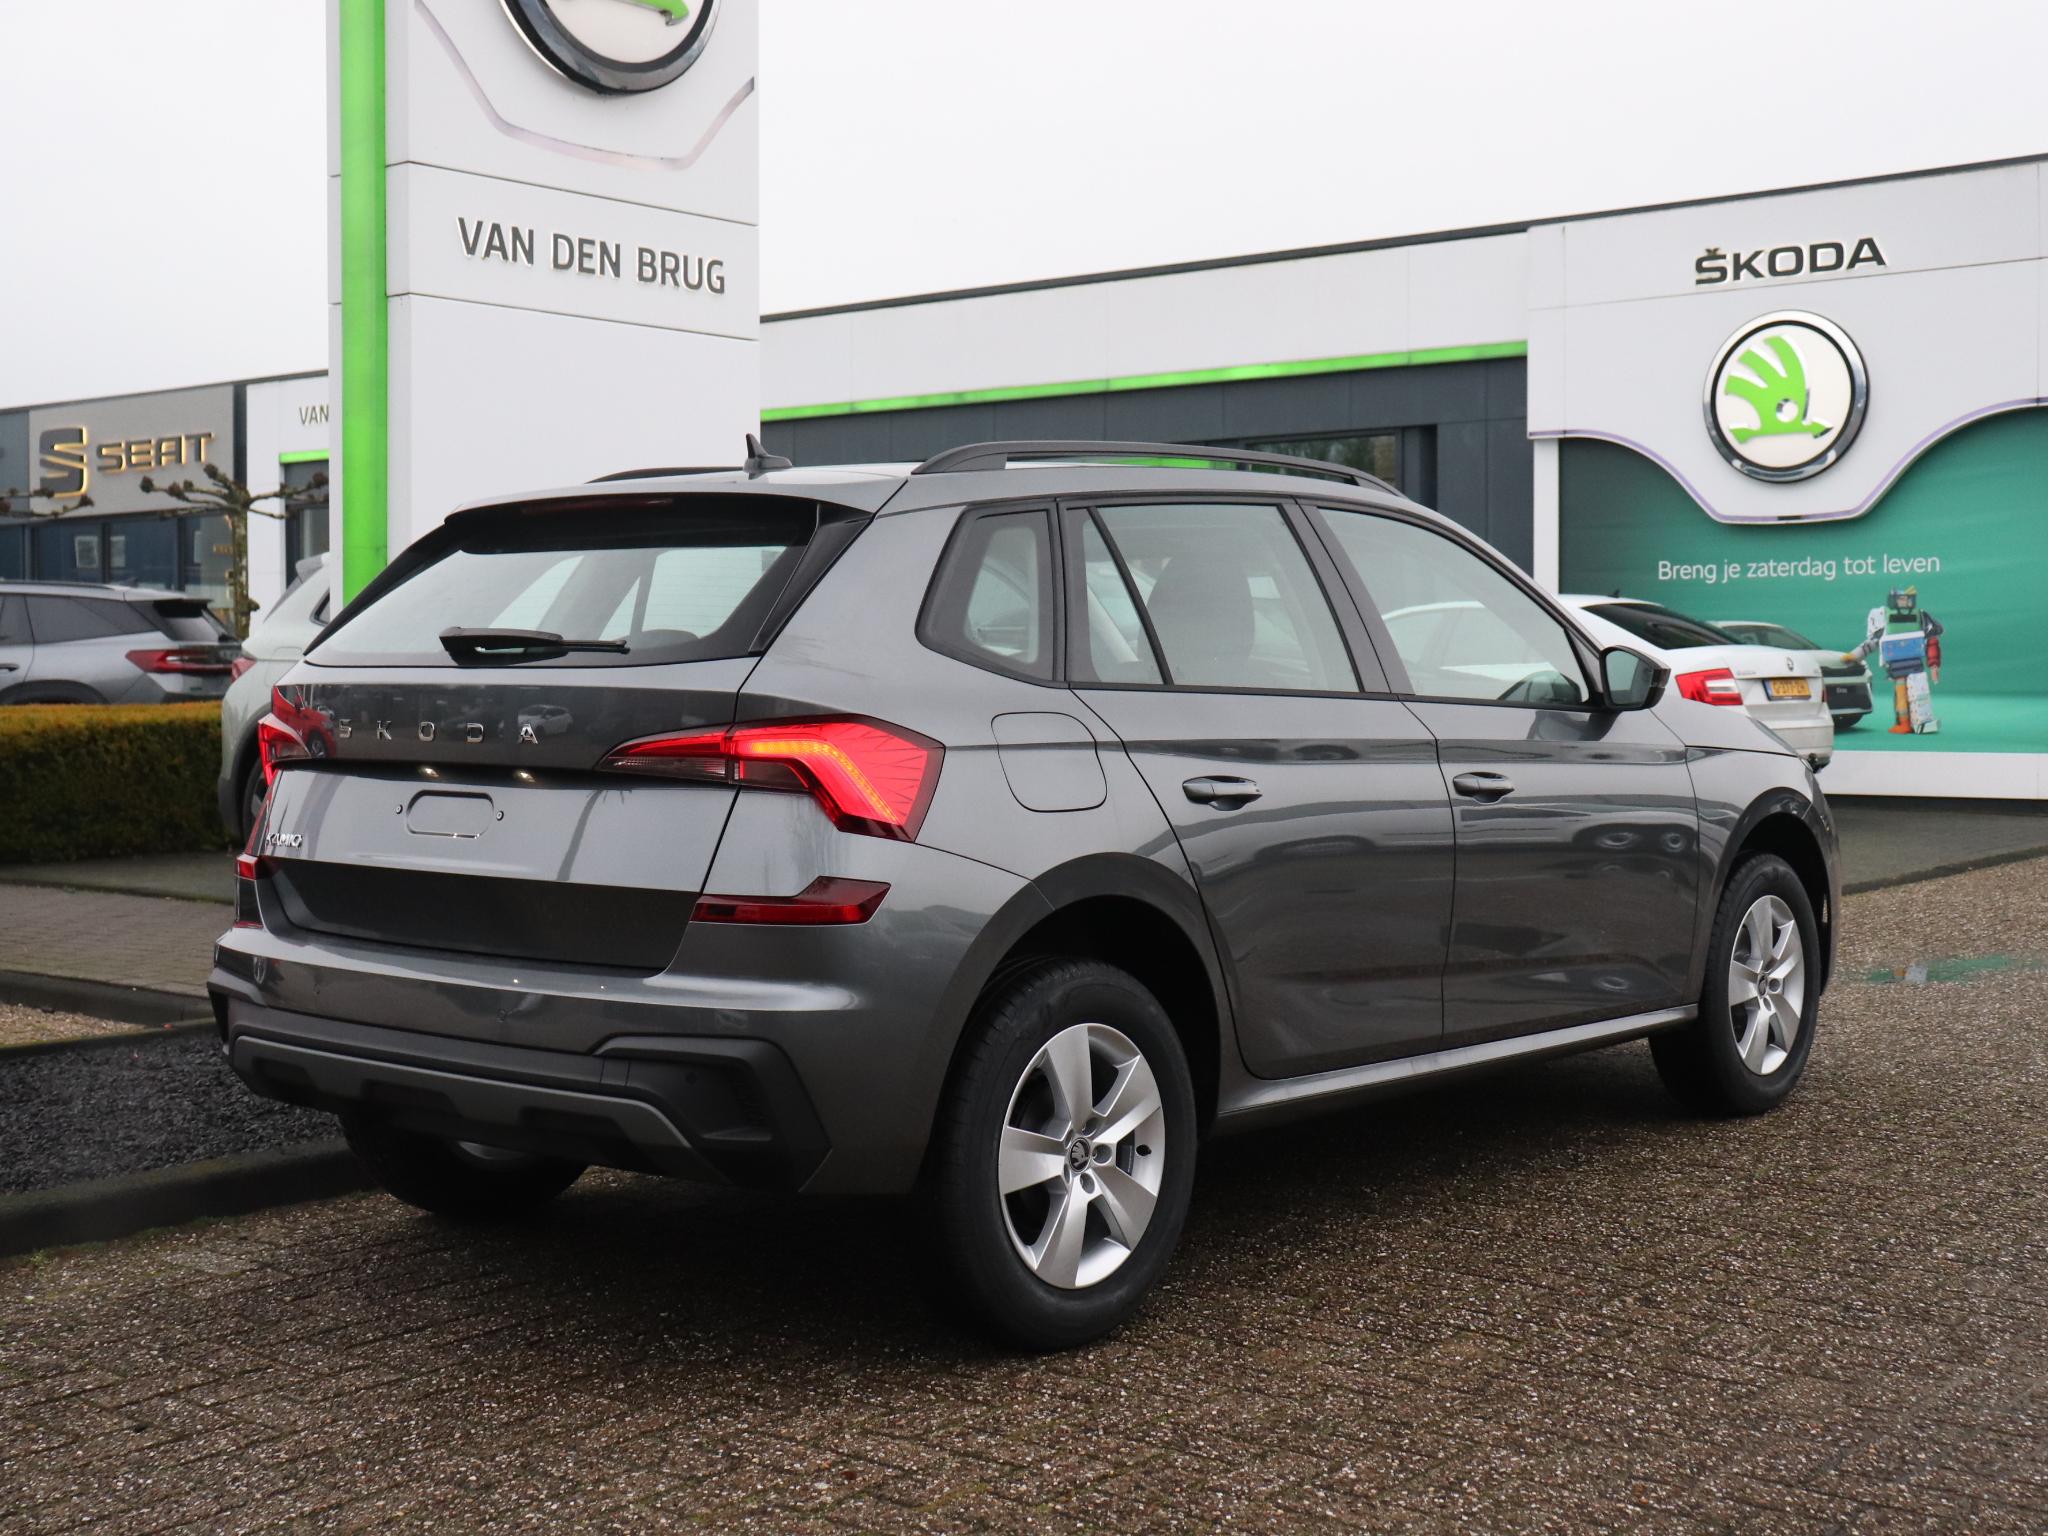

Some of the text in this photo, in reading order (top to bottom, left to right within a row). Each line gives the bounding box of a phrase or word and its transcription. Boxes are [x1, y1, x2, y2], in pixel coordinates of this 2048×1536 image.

[457, 216, 725, 294] VAN DEN BRUG
[1695, 237, 1887, 285] ŠKODA
[299, 404, 329, 425] VAN
[97, 432, 215, 474] SEAT
[1658, 553, 1940, 583] Breng je zaterdag tot leven
[338, 718, 539, 745] SKODA
